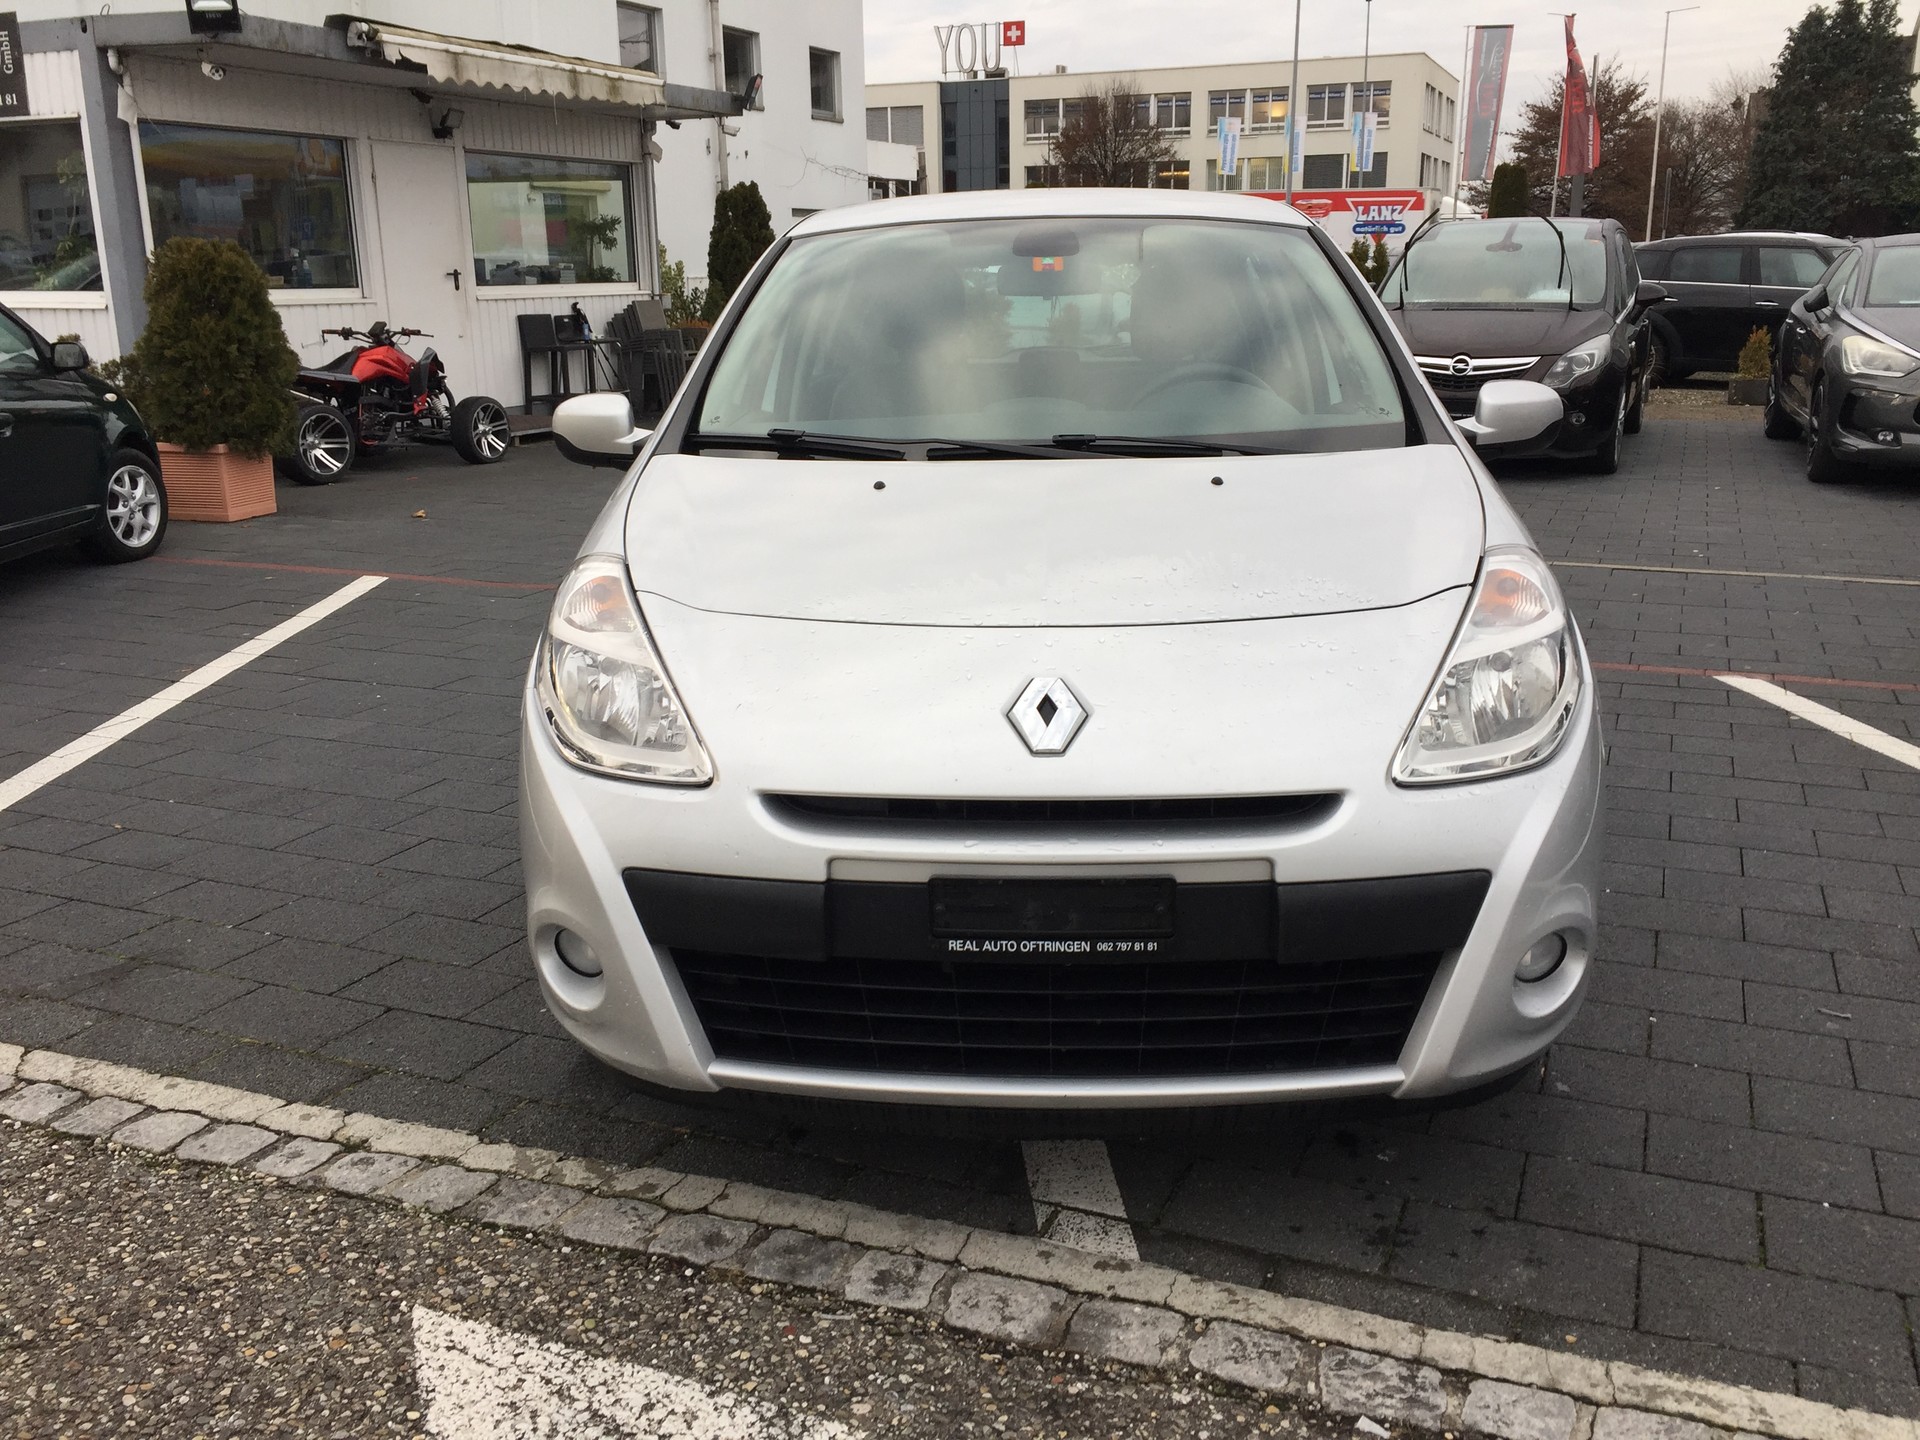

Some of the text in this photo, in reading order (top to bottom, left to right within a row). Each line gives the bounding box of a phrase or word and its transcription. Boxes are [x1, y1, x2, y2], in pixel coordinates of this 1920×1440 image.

[0, 30, 14, 74] GmbH
[934, 22, 1000, 74] YOU
[5, 93, 17, 105] 81
[1356, 205, 1403, 221] LANZ
[948, 940, 1157, 952] REAL AUTO OFTRINGEN 062 797 81 81
